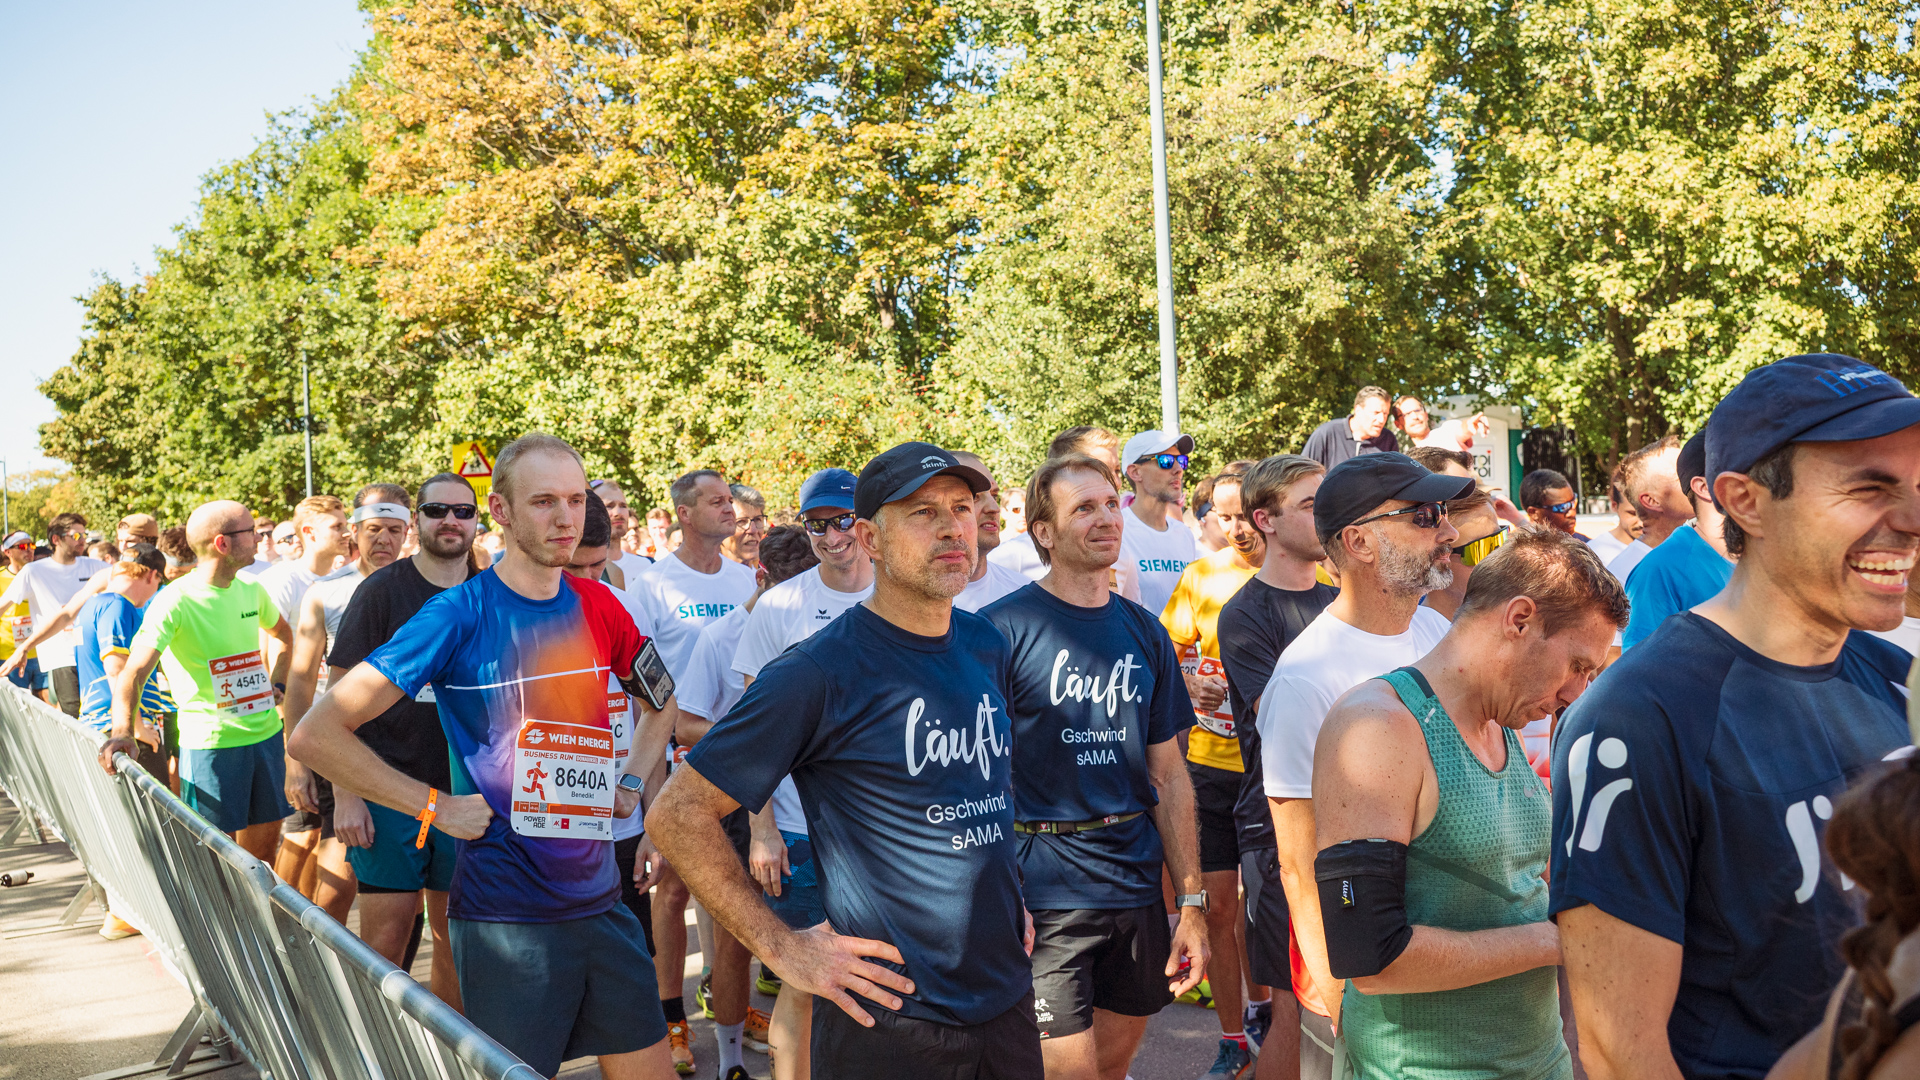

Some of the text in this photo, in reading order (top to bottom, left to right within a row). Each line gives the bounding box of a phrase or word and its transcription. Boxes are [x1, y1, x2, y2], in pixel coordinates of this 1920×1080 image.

[1139, 559, 1190, 573] SIEMEN
[1049, 648, 1143, 718] läuft.
[608, 698, 626, 708] ERGIE
[548, 732, 611, 751] WIEN ENERGIE
[904, 693, 1010, 781] läuft.
[1061, 726, 1126, 744] Gschwind
[524, 750, 558, 760] BUSINESS
[1076, 748, 1117, 766] sAMA
[555, 767, 608, 791] 8640A
[571, 790, 595, 800] Benedikt
[926, 790, 1006, 824] Gschwind
[523, 815, 546, 823] POWER
[951, 822, 1004, 851] sAMA
